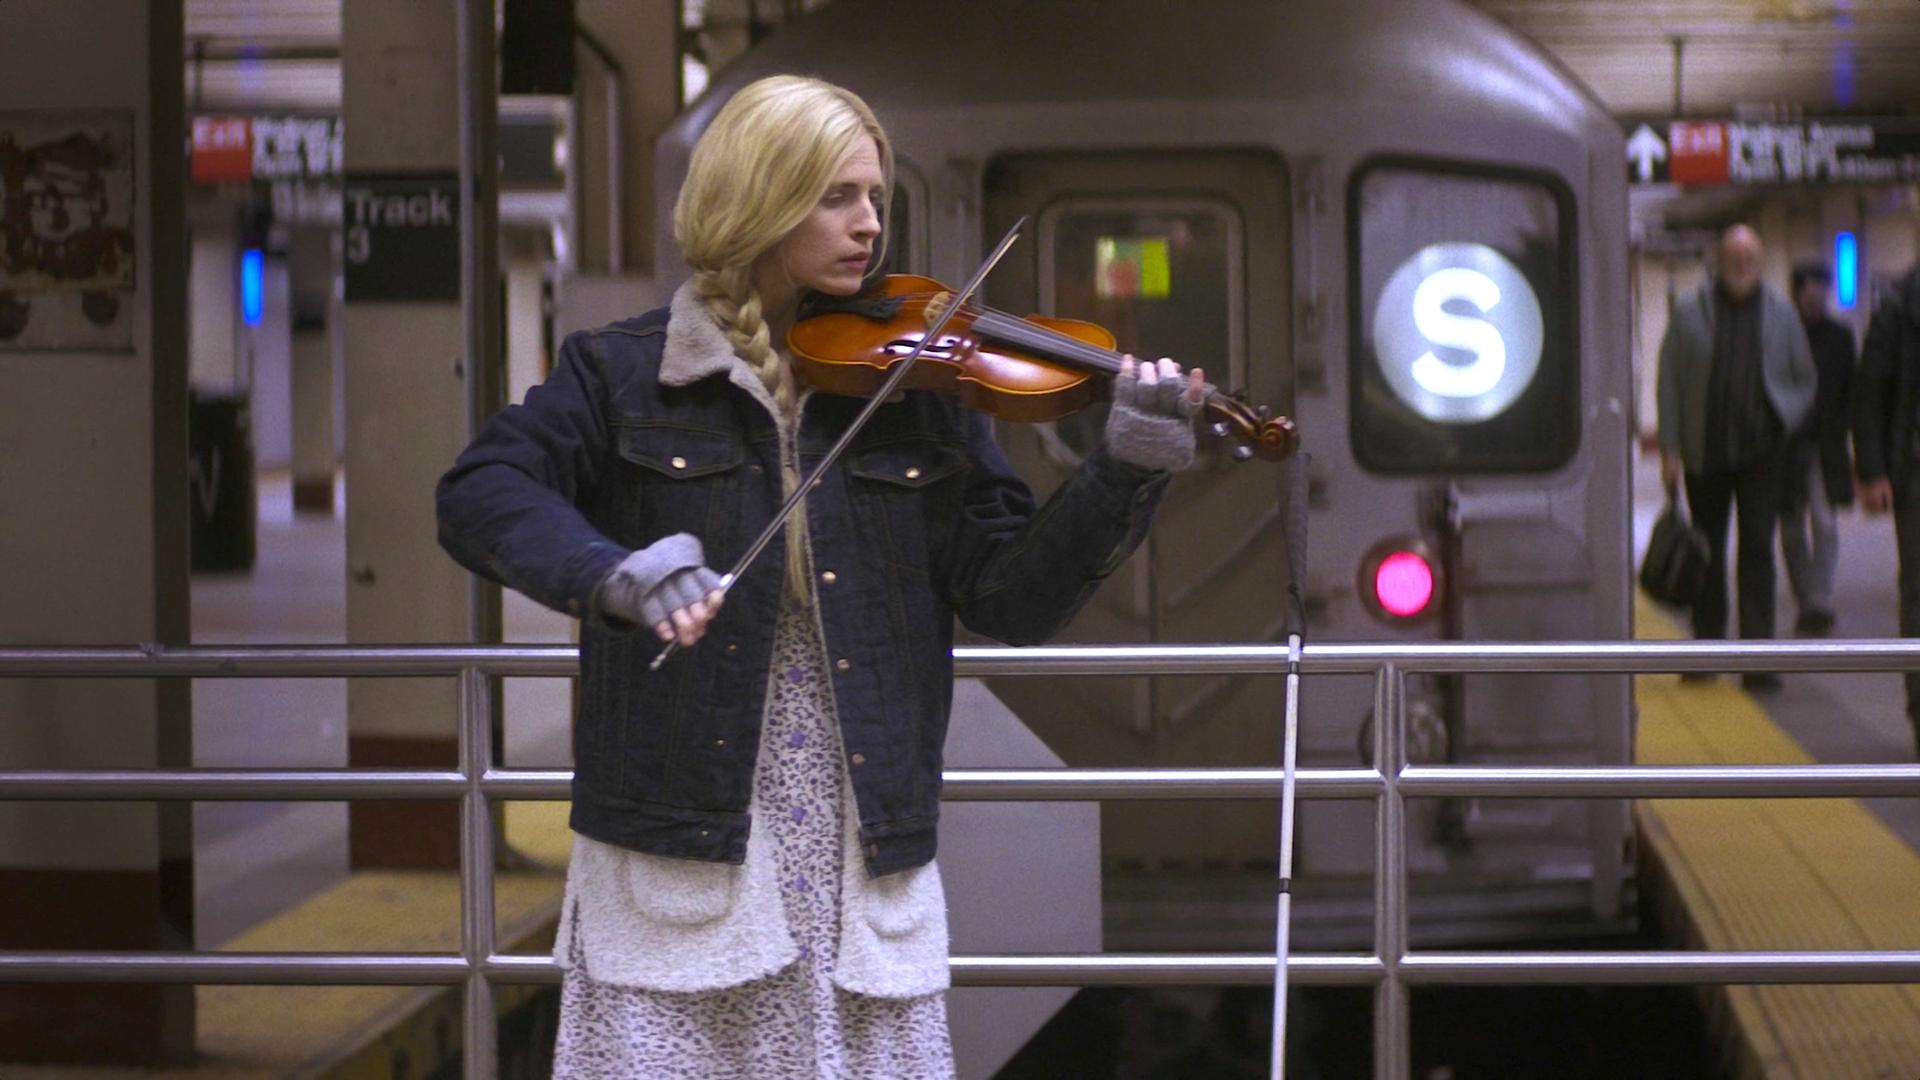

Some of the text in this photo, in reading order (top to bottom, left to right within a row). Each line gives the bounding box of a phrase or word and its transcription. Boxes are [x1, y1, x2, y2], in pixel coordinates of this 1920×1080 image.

[347, 187, 451, 226] Track
[347, 225, 371, 265] 3
[1411, 267, 1506, 399] S
